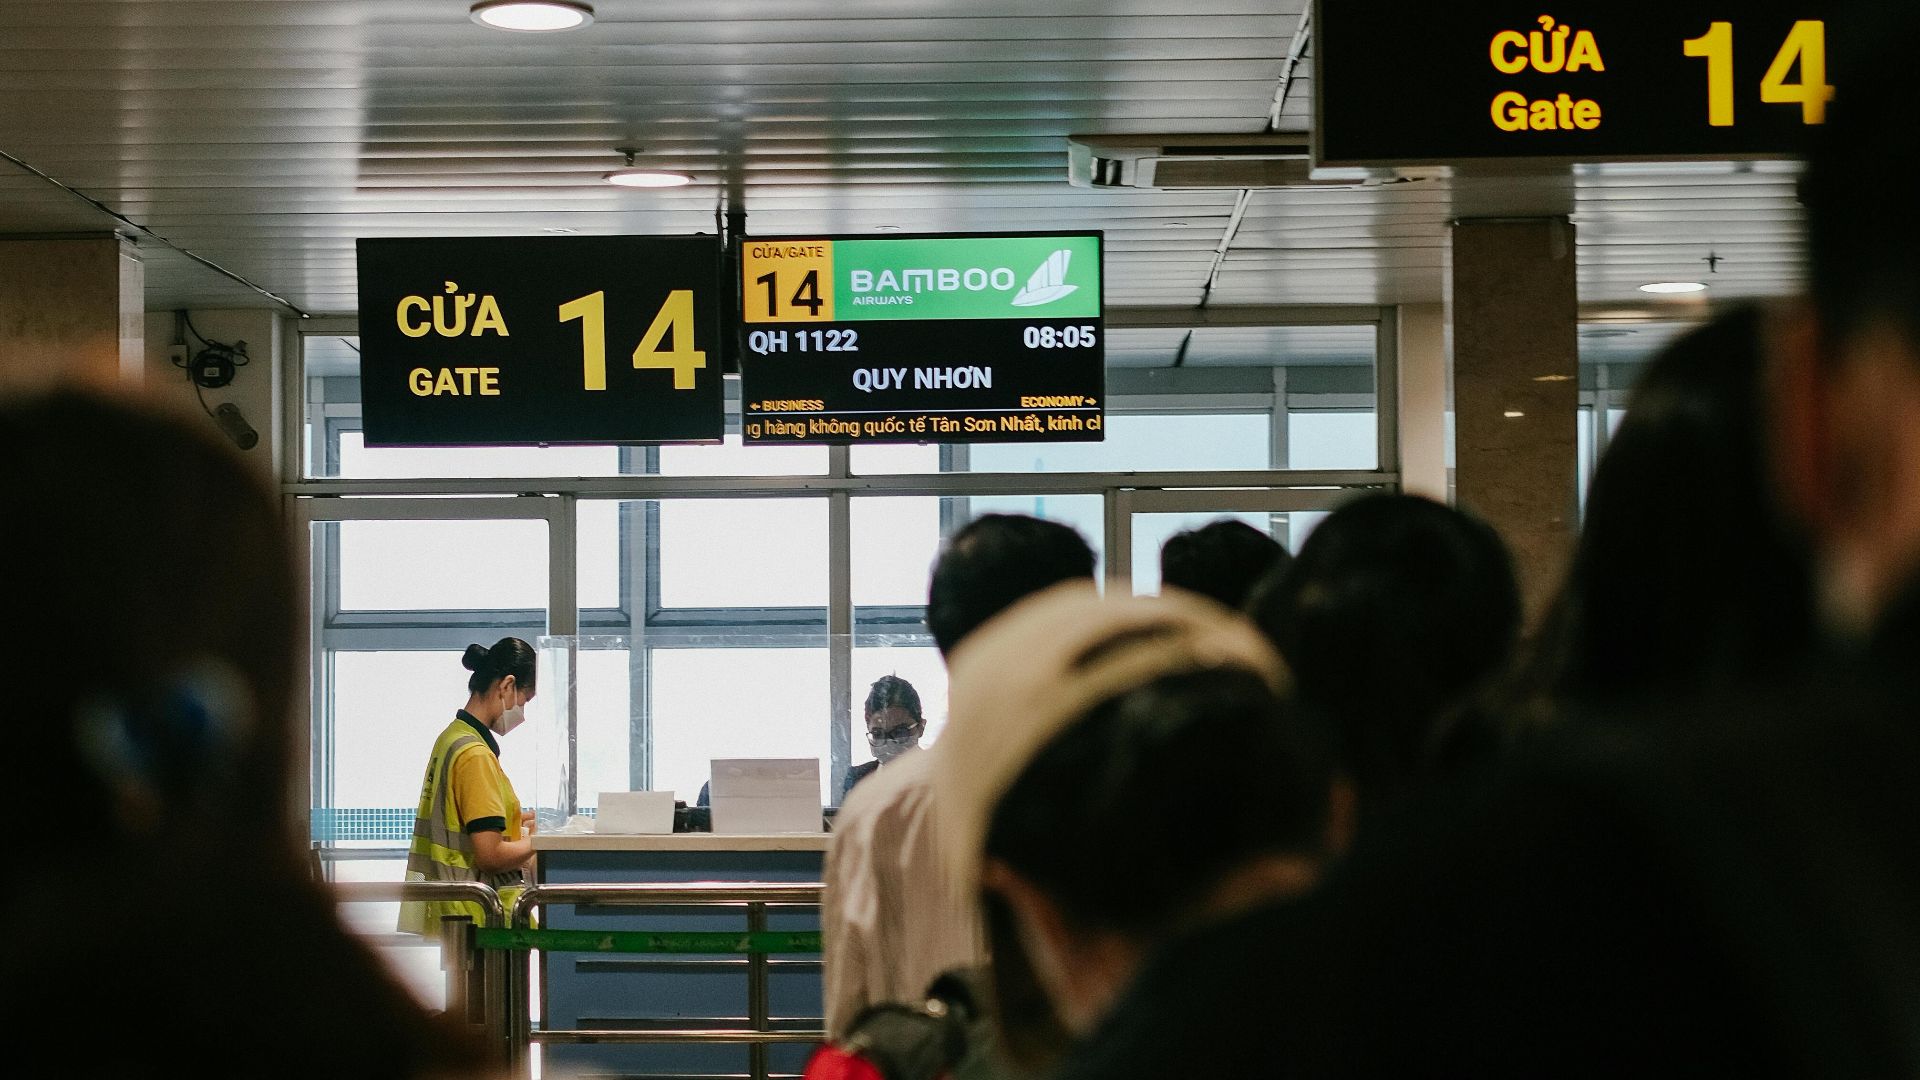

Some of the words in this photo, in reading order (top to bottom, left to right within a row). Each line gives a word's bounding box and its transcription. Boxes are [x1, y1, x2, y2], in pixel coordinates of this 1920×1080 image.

[1489, 14, 1605, 75] CỬA
[1683, 20, 1835, 127] 14
[1490, 90, 1602, 132] Gate
[752, 244, 825, 259] CỬA/GATE
[756, 269, 824, 317] 14
[850, 267, 1016, 293] BAMBOO
[396, 281, 510, 338] CỬA
[852, 295, 914, 306] AIRWAYS
[558, 289, 707, 391] 14
[748, 330, 788, 356] QH
[794, 329, 859, 352] 1122
[1023, 325, 1096, 349] 08:05
[408, 367, 501, 397] GATE
[852, 367, 908, 393] QUY
[914, 365, 992, 390] NHƠN
[761, 399, 825, 412] BUSINESS
[1020, 395, 1085, 408] ECONOMY
[764, 418, 806, 439] hàng
[809, 418, 861, 438] không
[863, 415, 905, 437] quốc
[908, 415, 927, 433] tế
[929, 416, 961, 433] Tân
[963, 416, 997, 432] Sơn
[1047, 414, 1083, 431] kính
